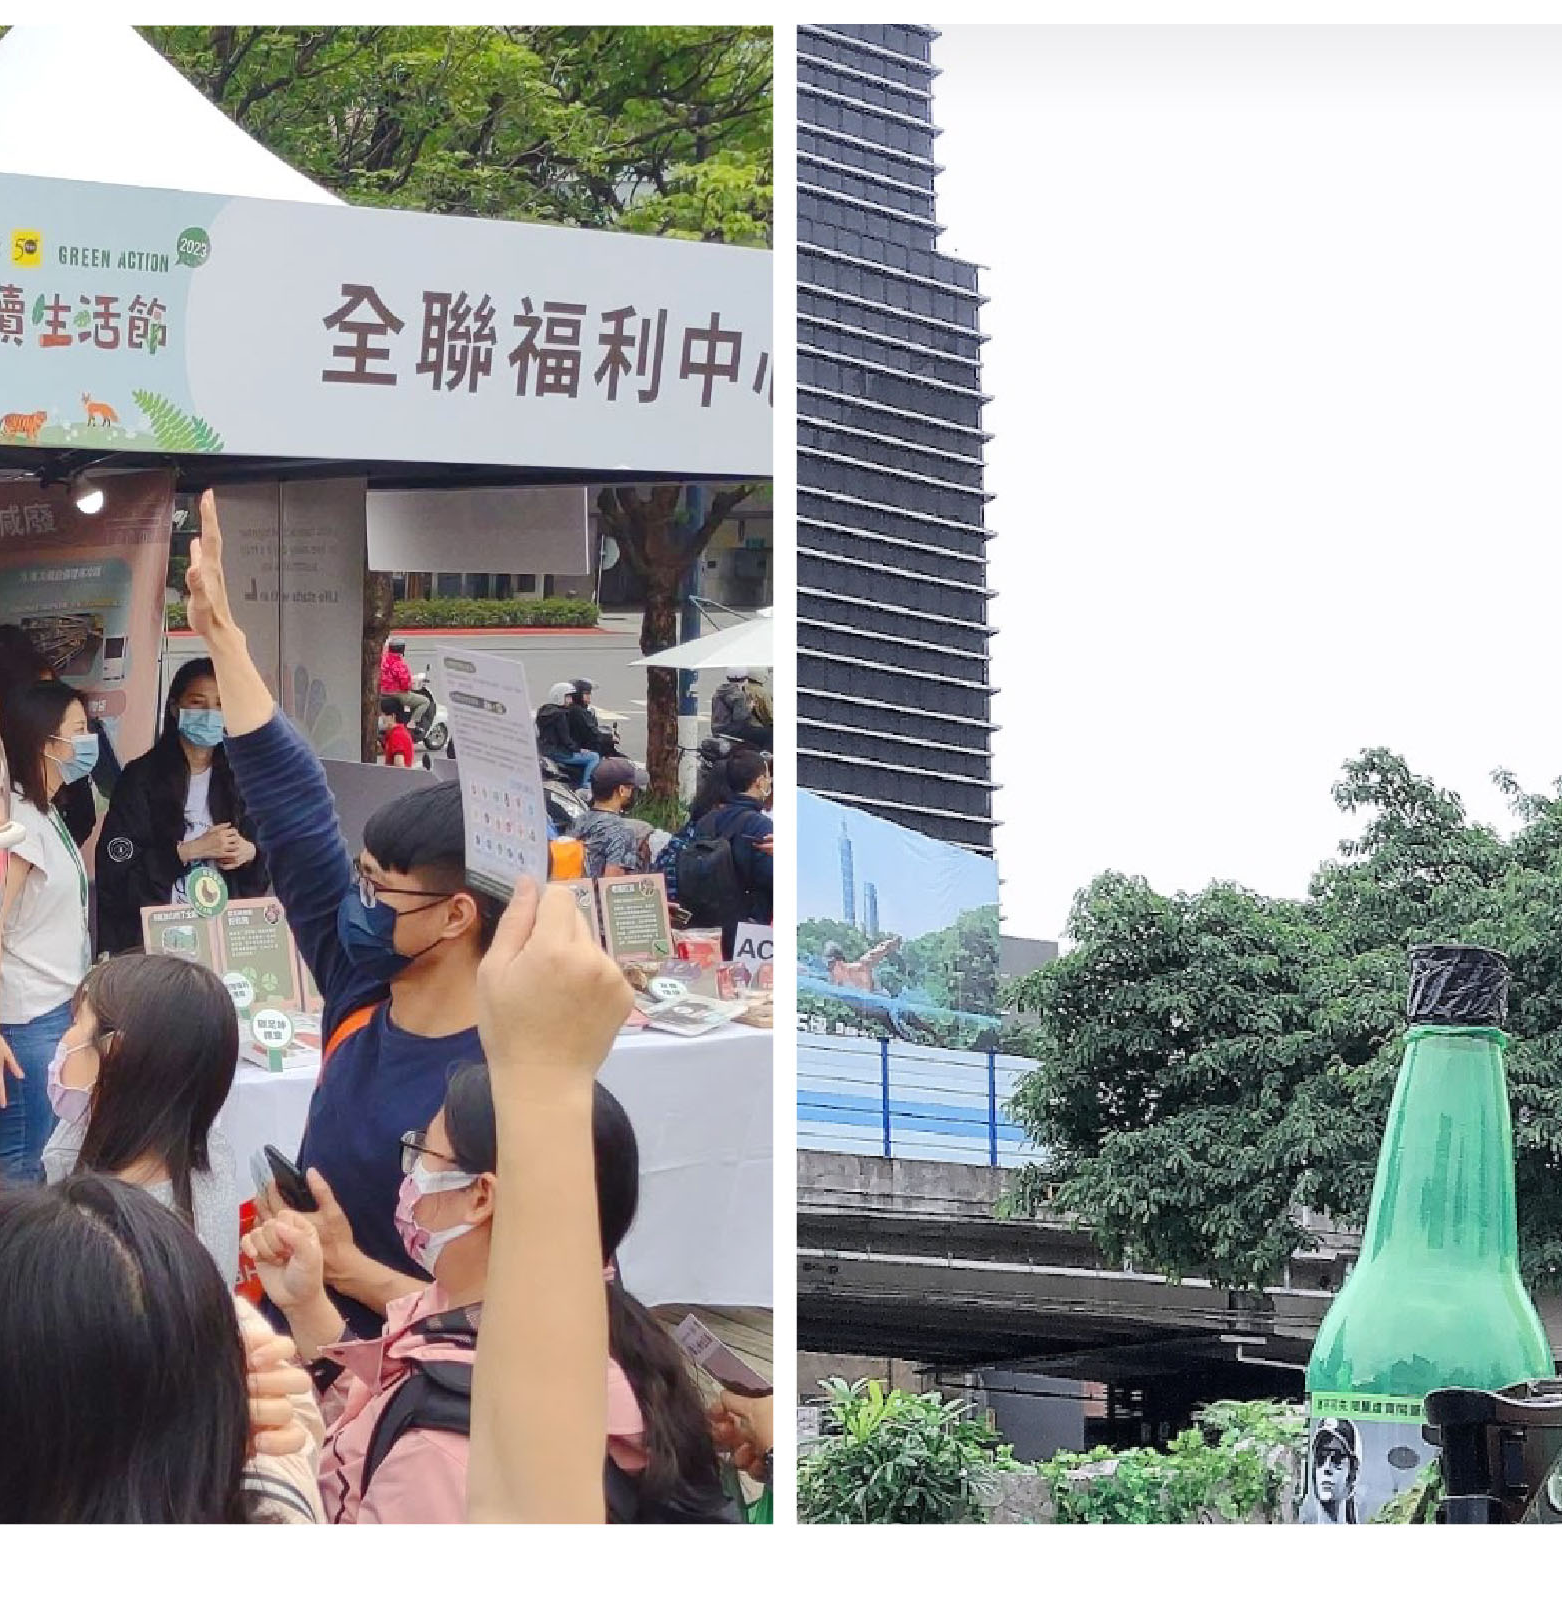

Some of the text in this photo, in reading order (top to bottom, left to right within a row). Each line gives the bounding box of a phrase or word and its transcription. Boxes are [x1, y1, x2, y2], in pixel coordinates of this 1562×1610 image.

[58, 238, 207, 273] GREEN ACTION 2023
